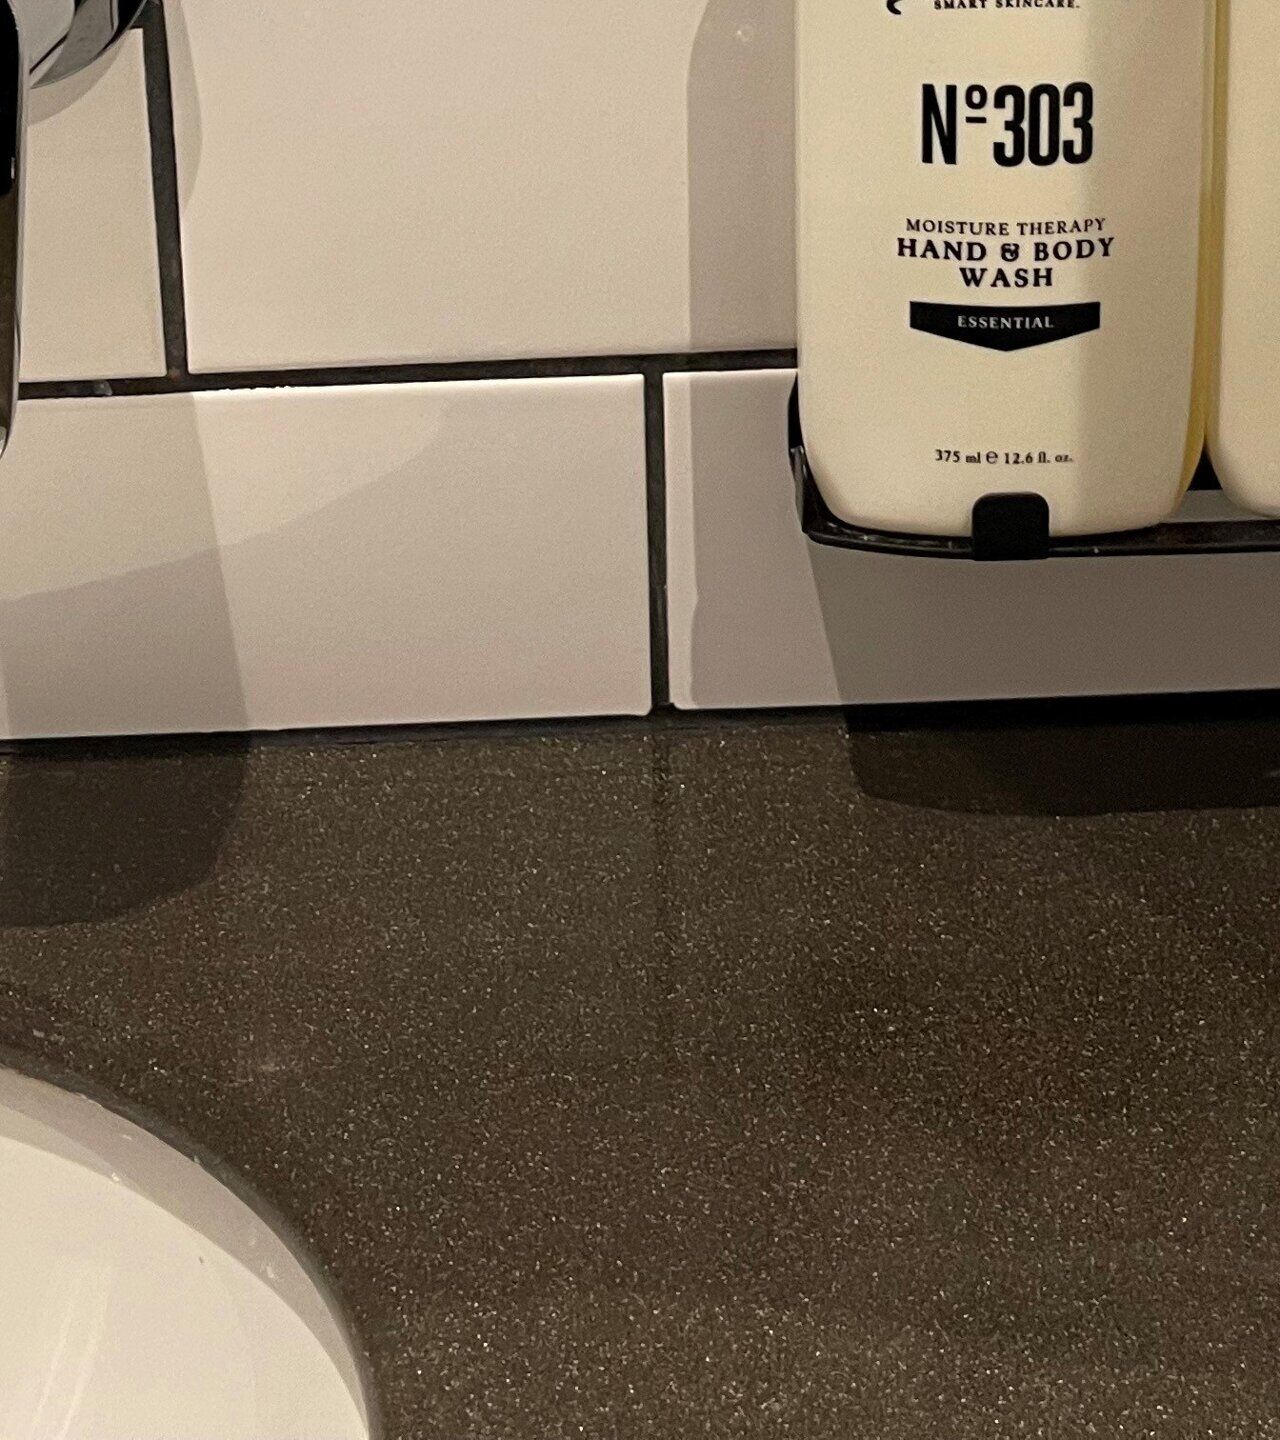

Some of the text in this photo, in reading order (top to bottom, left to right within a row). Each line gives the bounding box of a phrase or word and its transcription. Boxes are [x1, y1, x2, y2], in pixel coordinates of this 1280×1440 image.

[906, 217, 1106, 236] MOISTURE THERAPY
[897, 237, 1115, 262] HAND & BODY
[959, 267, 1053, 288] WASH
[957, 315, 1055, 329] ESSENTIAL
[935, 449, 961, 463] 375
[965, 451, 981, 464] ml
[1004, 452, 1033, 464] 12.6
